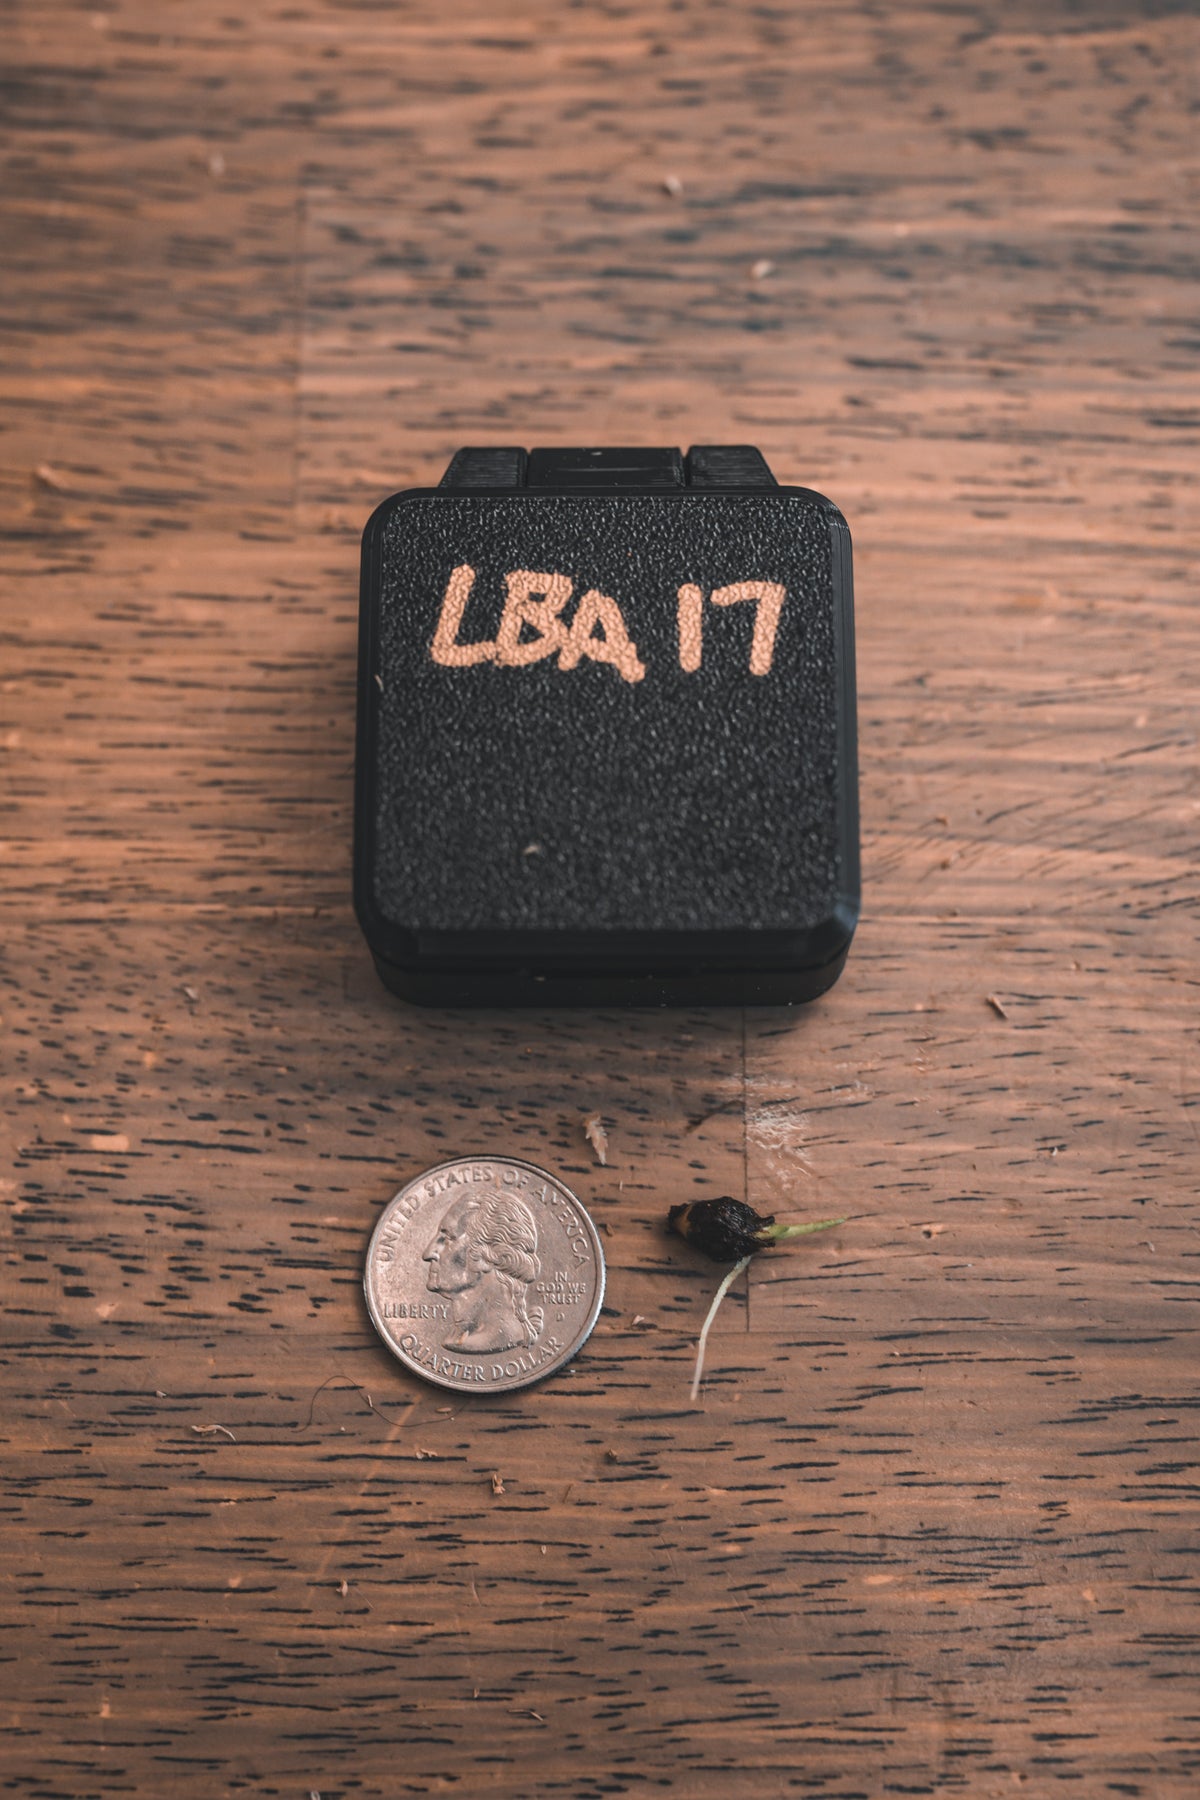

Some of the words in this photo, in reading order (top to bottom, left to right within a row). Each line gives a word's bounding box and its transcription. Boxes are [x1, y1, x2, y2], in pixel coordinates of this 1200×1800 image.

[430, 563, 646, 684] LBA
[677, 580, 787, 677] 17
[375, 1194, 421, 1263] UNITED
[423, 1165, 495, 1198] STATES
[502, 1169, 531, 1190] OF
[530, 1183, 591, 1270] AMERICA
[554, 1271, 568, 1282] IN
[536, 1281, 564, 1294] GOD
[568, 1282, 587, 1294] WE
[542, 1293, 582, 1305] TRUST
[383, 1303, 450, 1319] LIBERTY
[400, 1333, 486, 1382] QUARTER
[491, 1335, 565, 1381] DOLLAR
